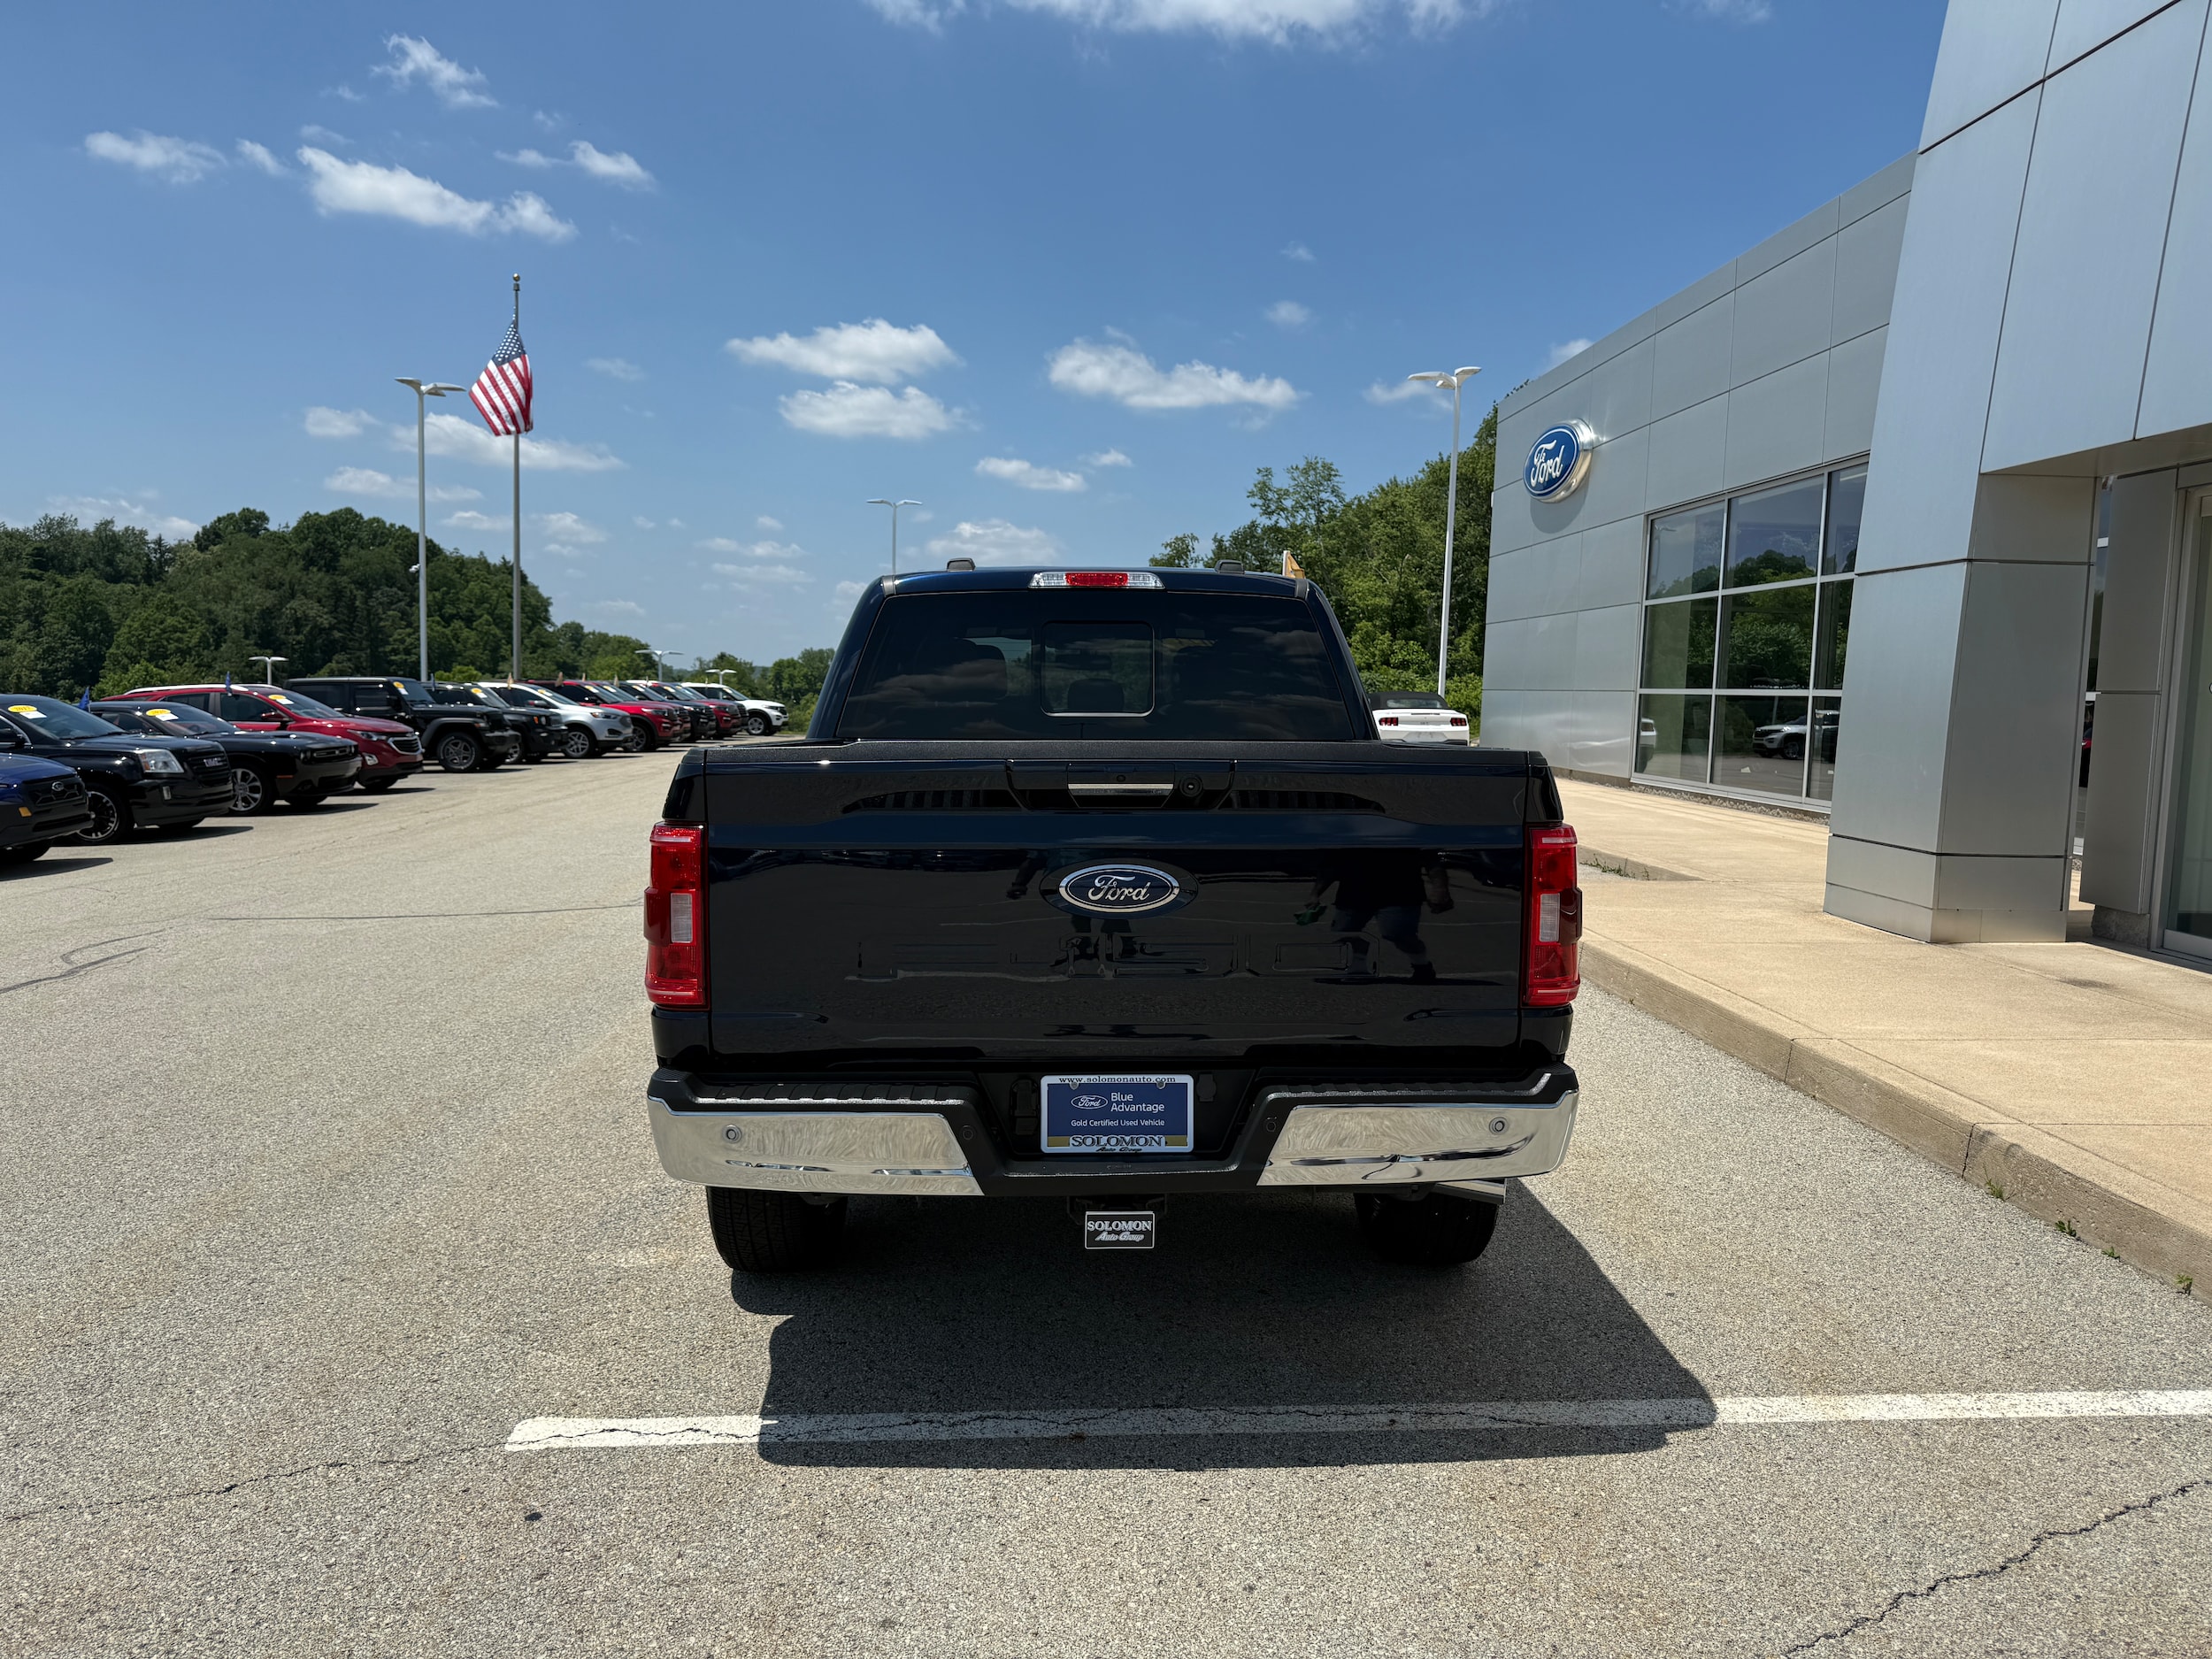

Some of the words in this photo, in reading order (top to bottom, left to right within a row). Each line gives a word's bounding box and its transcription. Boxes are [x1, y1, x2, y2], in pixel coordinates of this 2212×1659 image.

[1530, 440, 1564, 487] Ford
[1087, 874, 1151, 901] Ford
[1058, 1075, 1176, 1084] www.solomonauto.com
[1078, 1096, 1102, 1107] Ford
[1110, 1092, 1133, 1102] Blue
[1110, 1102, 1165, 1113] Advantage
[1071, 1136, 1164, 1147] SOLOMON
[1087, 1221, 1152, 1232] SOLOMON
[1094, 1231, 1118, 1241] Auto
[1118, 1231, 1145, 1242] Group
